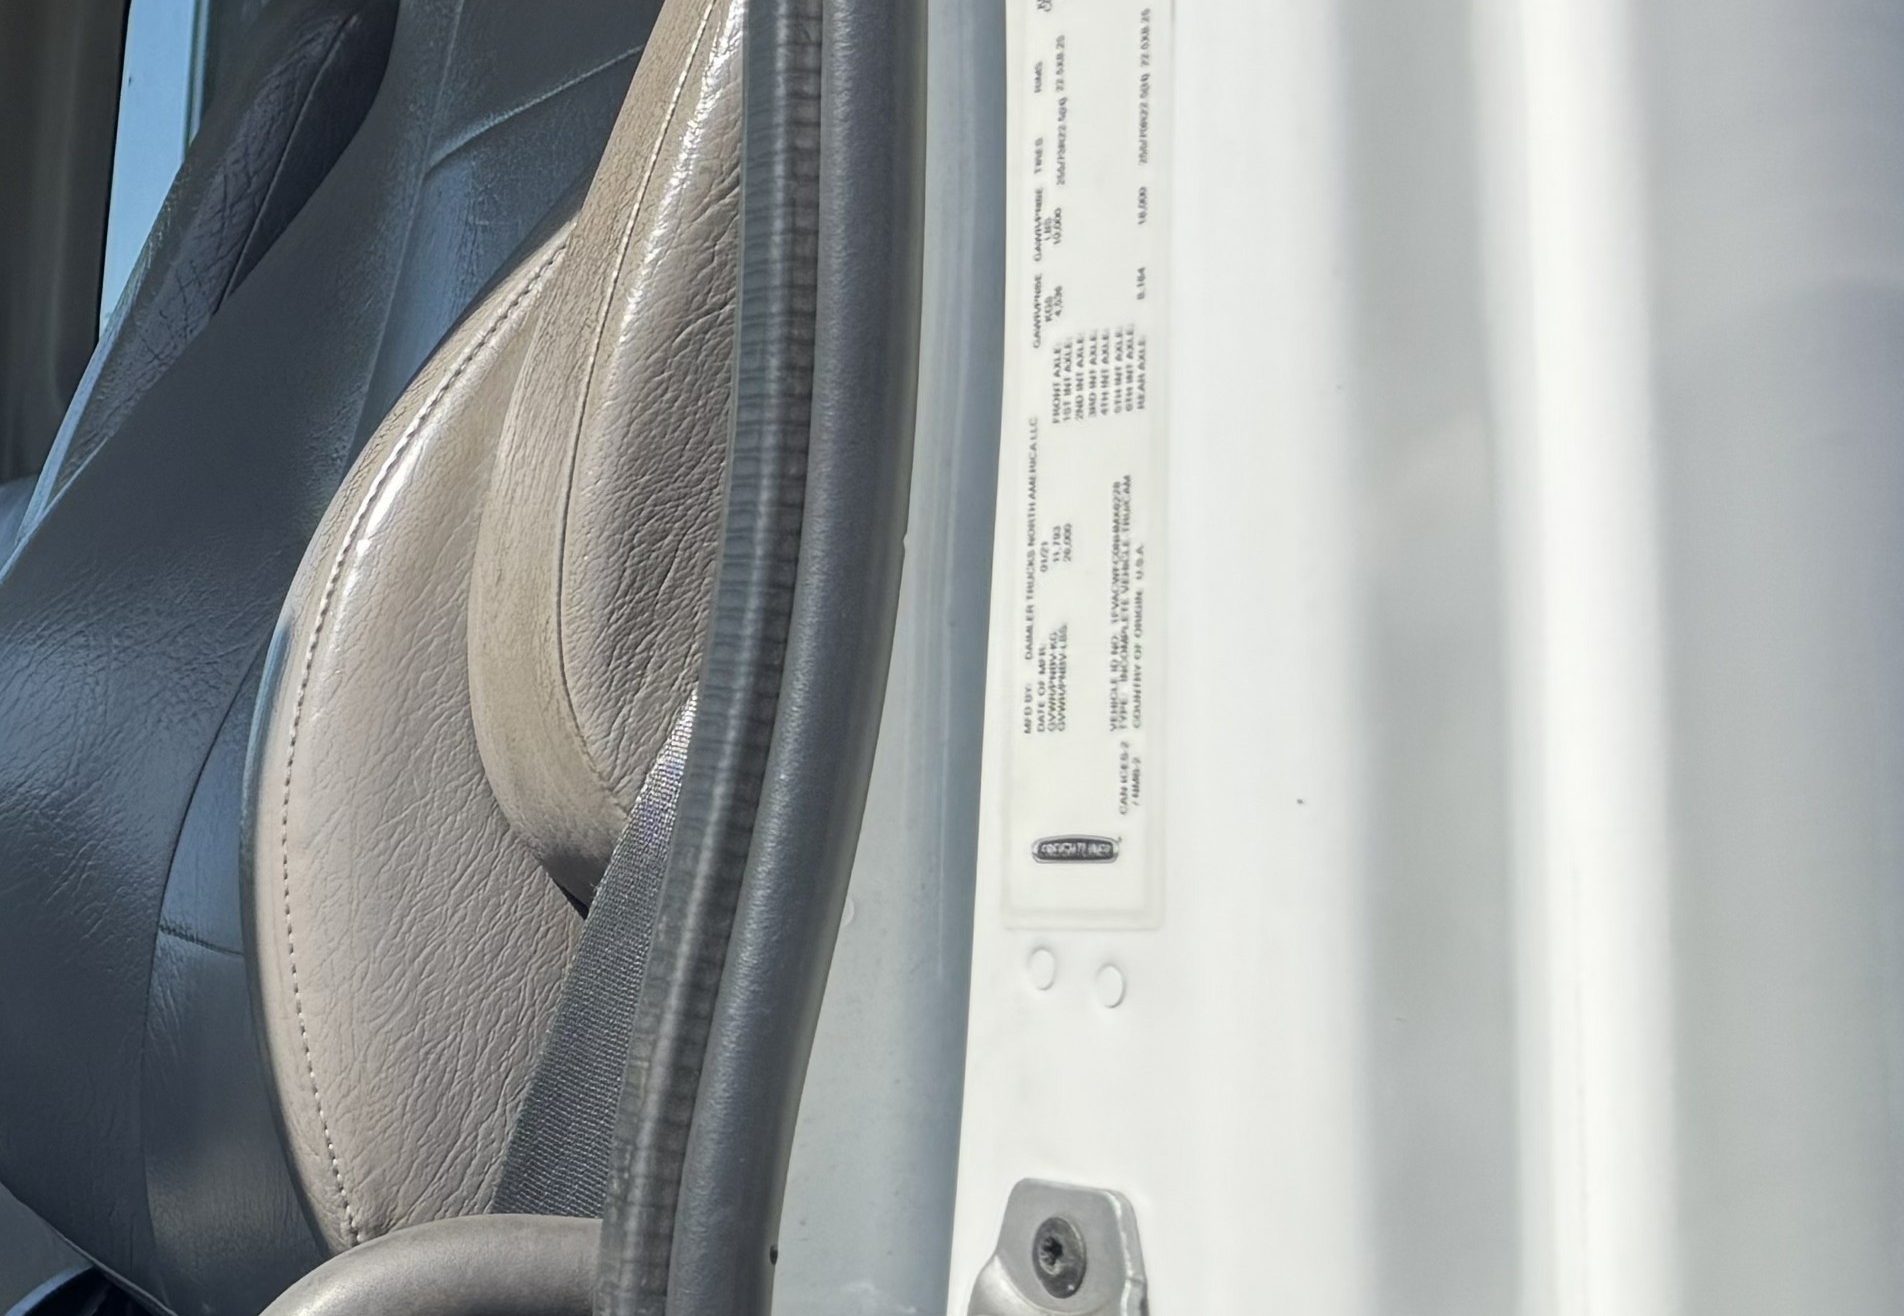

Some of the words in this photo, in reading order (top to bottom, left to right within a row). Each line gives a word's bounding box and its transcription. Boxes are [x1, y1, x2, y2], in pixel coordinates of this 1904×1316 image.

[1028, 417, 1038, 440] LLC
[1052, 382, 1061, 424] FRONT
[1027, 443, 1037, 500] AMERICA
[1026, 503, 1036, 546] NORTH
[1025, 550, 1036, 601] TRUCKS
[1025, 604, 1035, 660] DAIMLER
[1120, 599, 1130, 682] INCOMPLETE
[1037, 680, 1046, 696] OF
[1110, 678, 1119, 732] VEHICLE
[1133, 665, 1142, 729] COUNTRY
[1037, 701, 1045, 732] DATE
